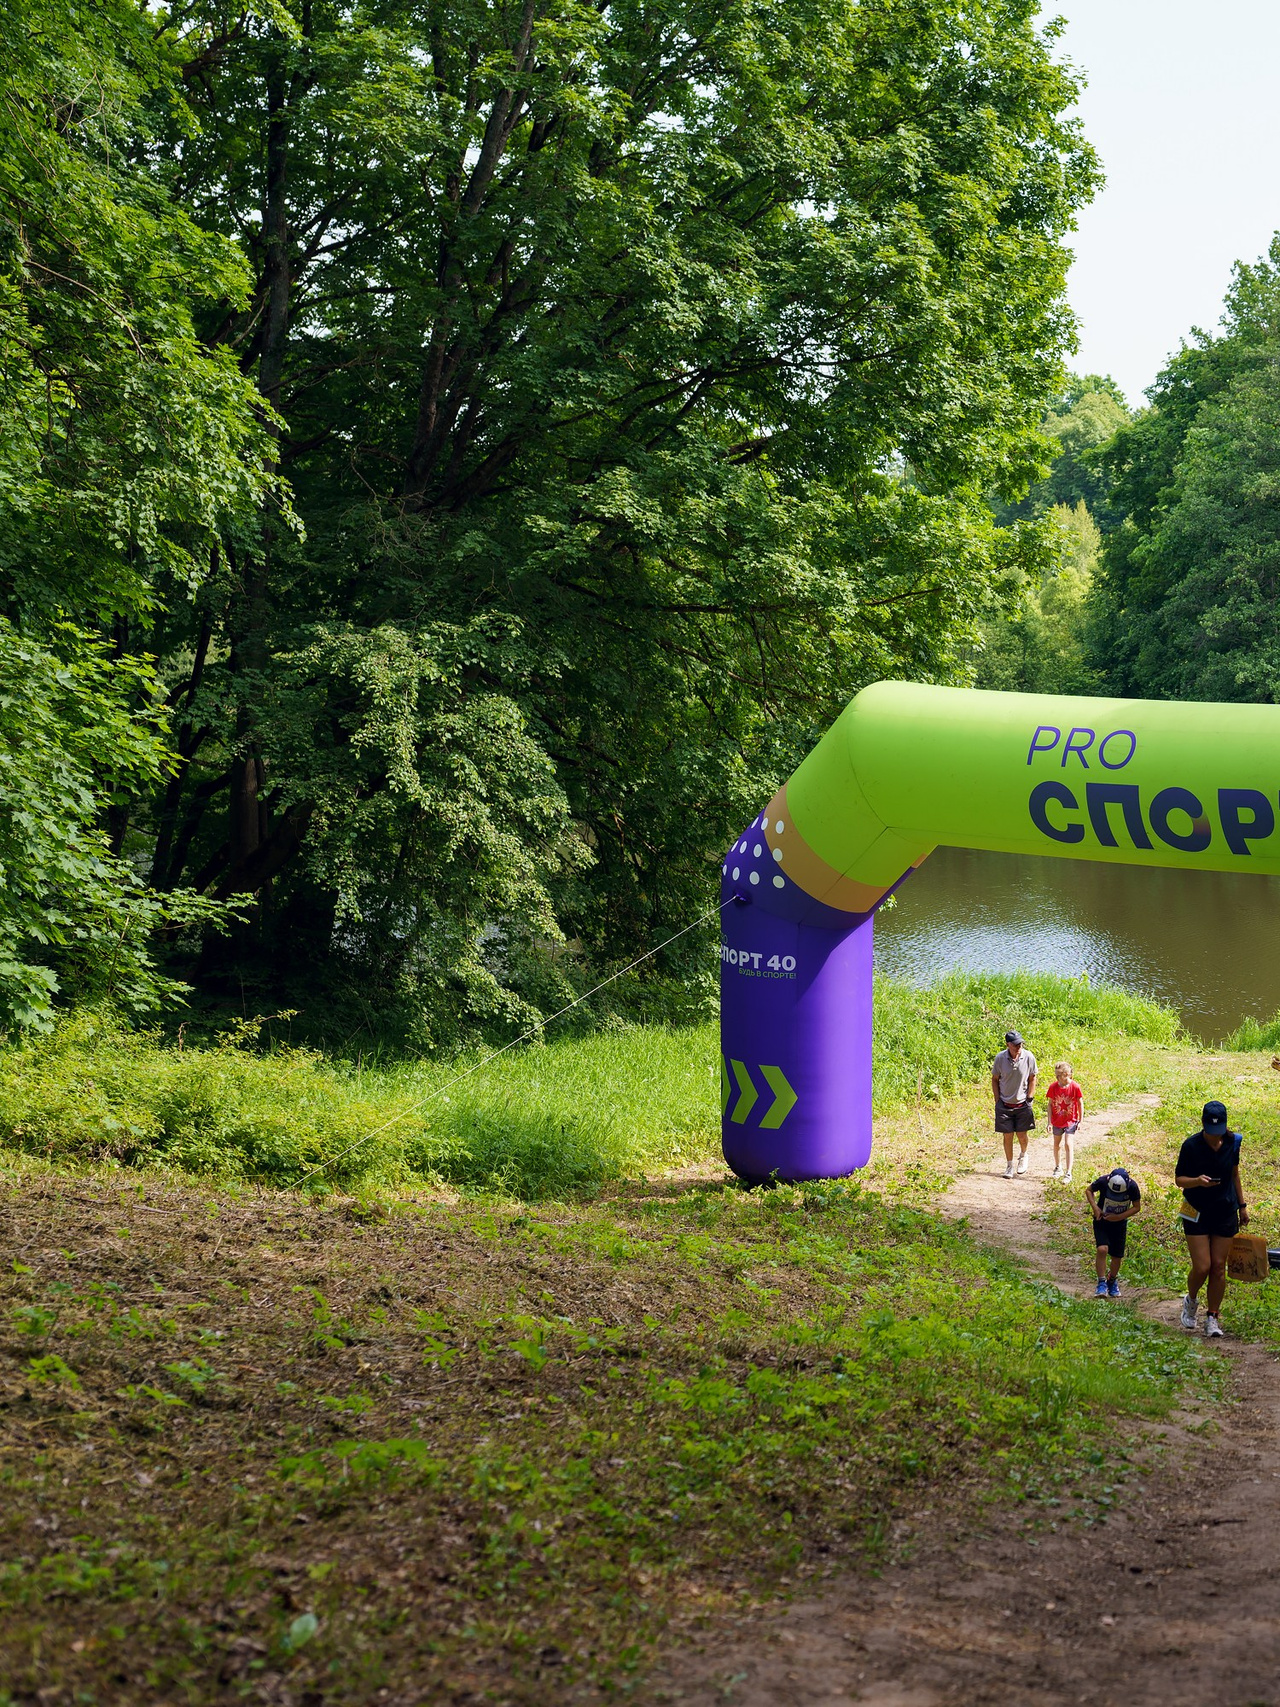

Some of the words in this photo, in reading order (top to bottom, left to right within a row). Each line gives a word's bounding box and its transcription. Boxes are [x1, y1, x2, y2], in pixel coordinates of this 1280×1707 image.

[1026, 725, 1137, 771] PRO
[767, 955, 796, 971] 40
[738, 968, 755, 977] БУДЬ
